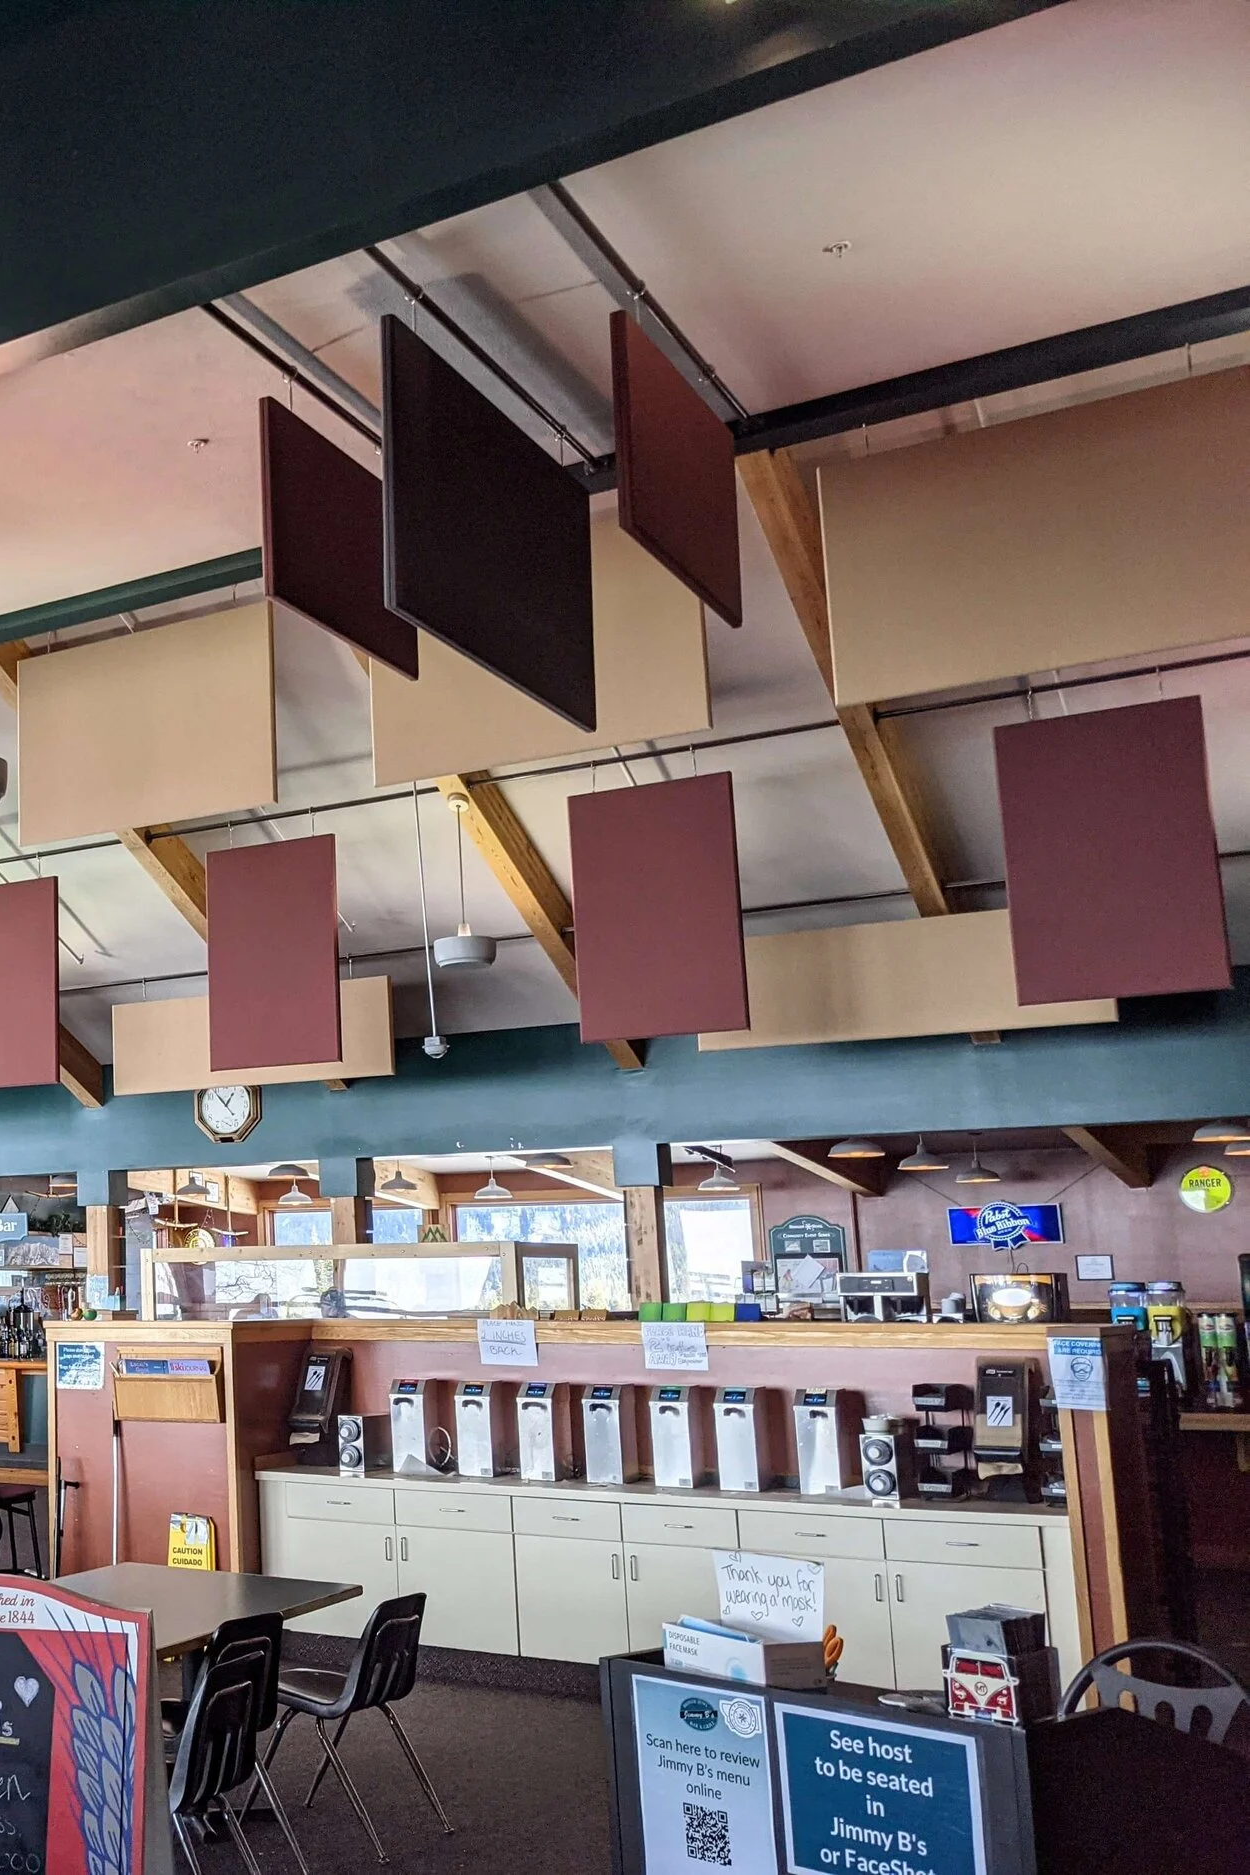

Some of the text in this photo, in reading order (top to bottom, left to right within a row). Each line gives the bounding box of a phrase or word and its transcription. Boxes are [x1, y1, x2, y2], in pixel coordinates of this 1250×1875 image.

[1188, 1178, 1222, 1188] RANGER
[985, 1209, 1011, 1224] Pabst
[976, 1226, 997, 1239] Blue
[995, 1218, 1031, 1231] Ribbon
[492, 1330, 527, 1343] INCHES
[490, 1345, 522, 1356] BACK
[172, 1547, 203, 1555] CAUTION
[172, 1557, 203, 1566] CUIDADO
[721, 1564, 814, 1597] Thank you for
[20, 1595, 35, 1607] in
[726, 1590, 817, 1617] wearing a mask!
[8, 1610, 35, 1623] 1844
[668, 1631, 700, 1646] DISPOSABLE
[669, 1643, 698, 1656] FACE MASK
[646, 1733, 760, 1768] Scan here to review
[830, 1729, 913, 1763] See host
[657, 1755, 751, 1787] Jimmy B's menu
[814, 1756, 934, 1797] to be seated
[686, 1783, 722, 1800] online
[865, 1794, 885, 1817] in
[830, 1817, 928, 1856] Jimmy B's
[820, 1847, 841, 1865] or
